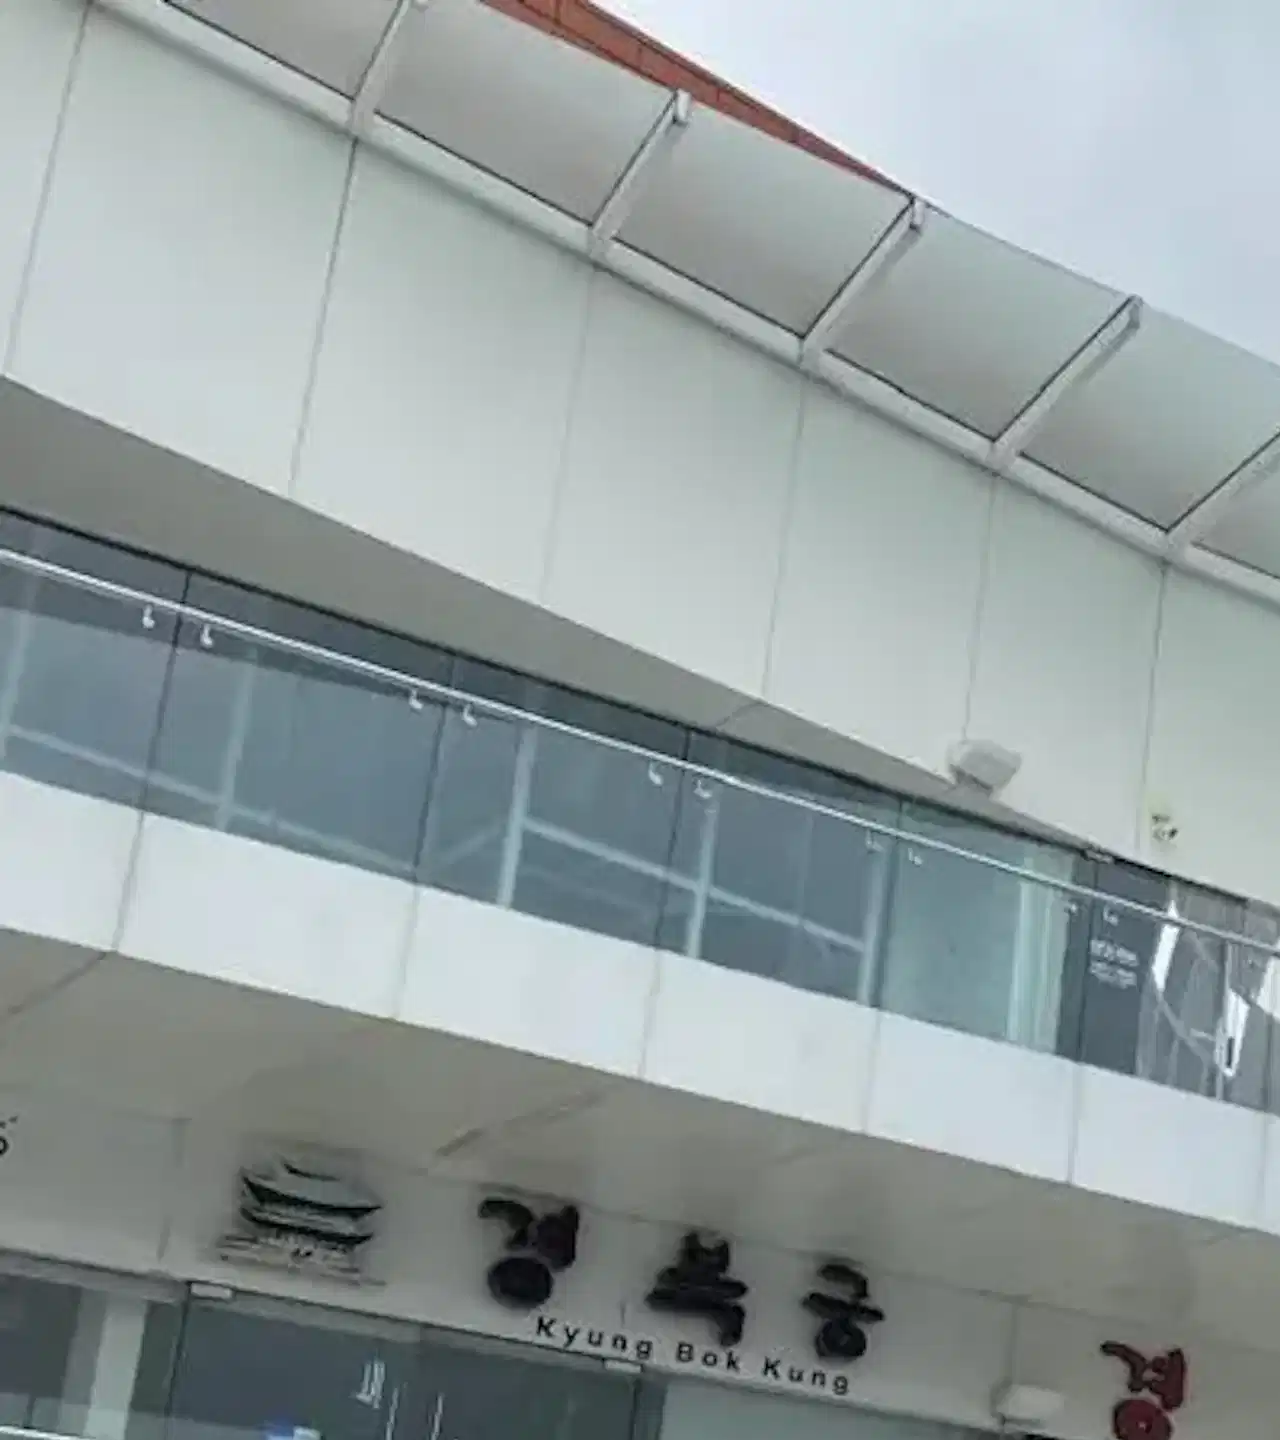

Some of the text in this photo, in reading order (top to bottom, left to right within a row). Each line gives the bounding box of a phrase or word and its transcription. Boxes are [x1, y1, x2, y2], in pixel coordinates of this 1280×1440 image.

[535, 1315, 850, 1395] Kyung Bok Kung
